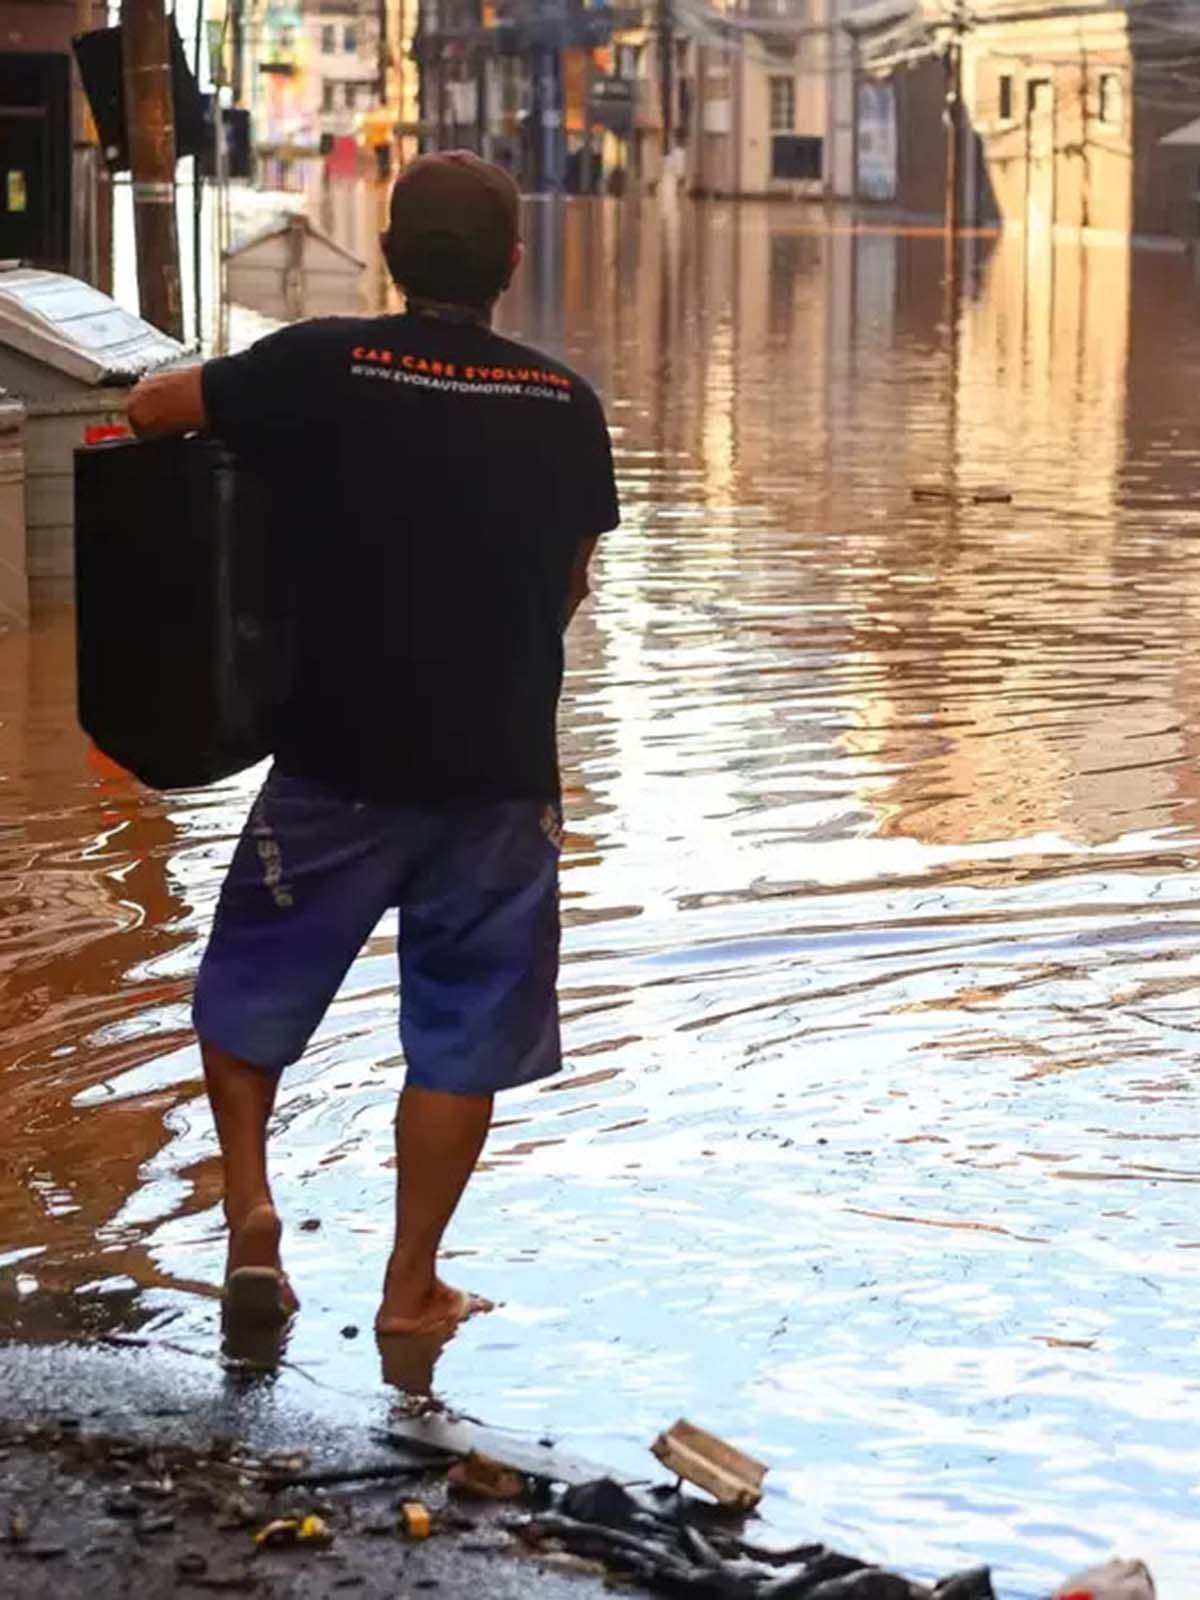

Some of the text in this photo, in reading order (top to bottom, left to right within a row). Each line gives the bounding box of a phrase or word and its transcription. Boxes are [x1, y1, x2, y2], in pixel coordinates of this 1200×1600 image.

[352, 347, 570, 386] CAR CARE EVOLUTION
